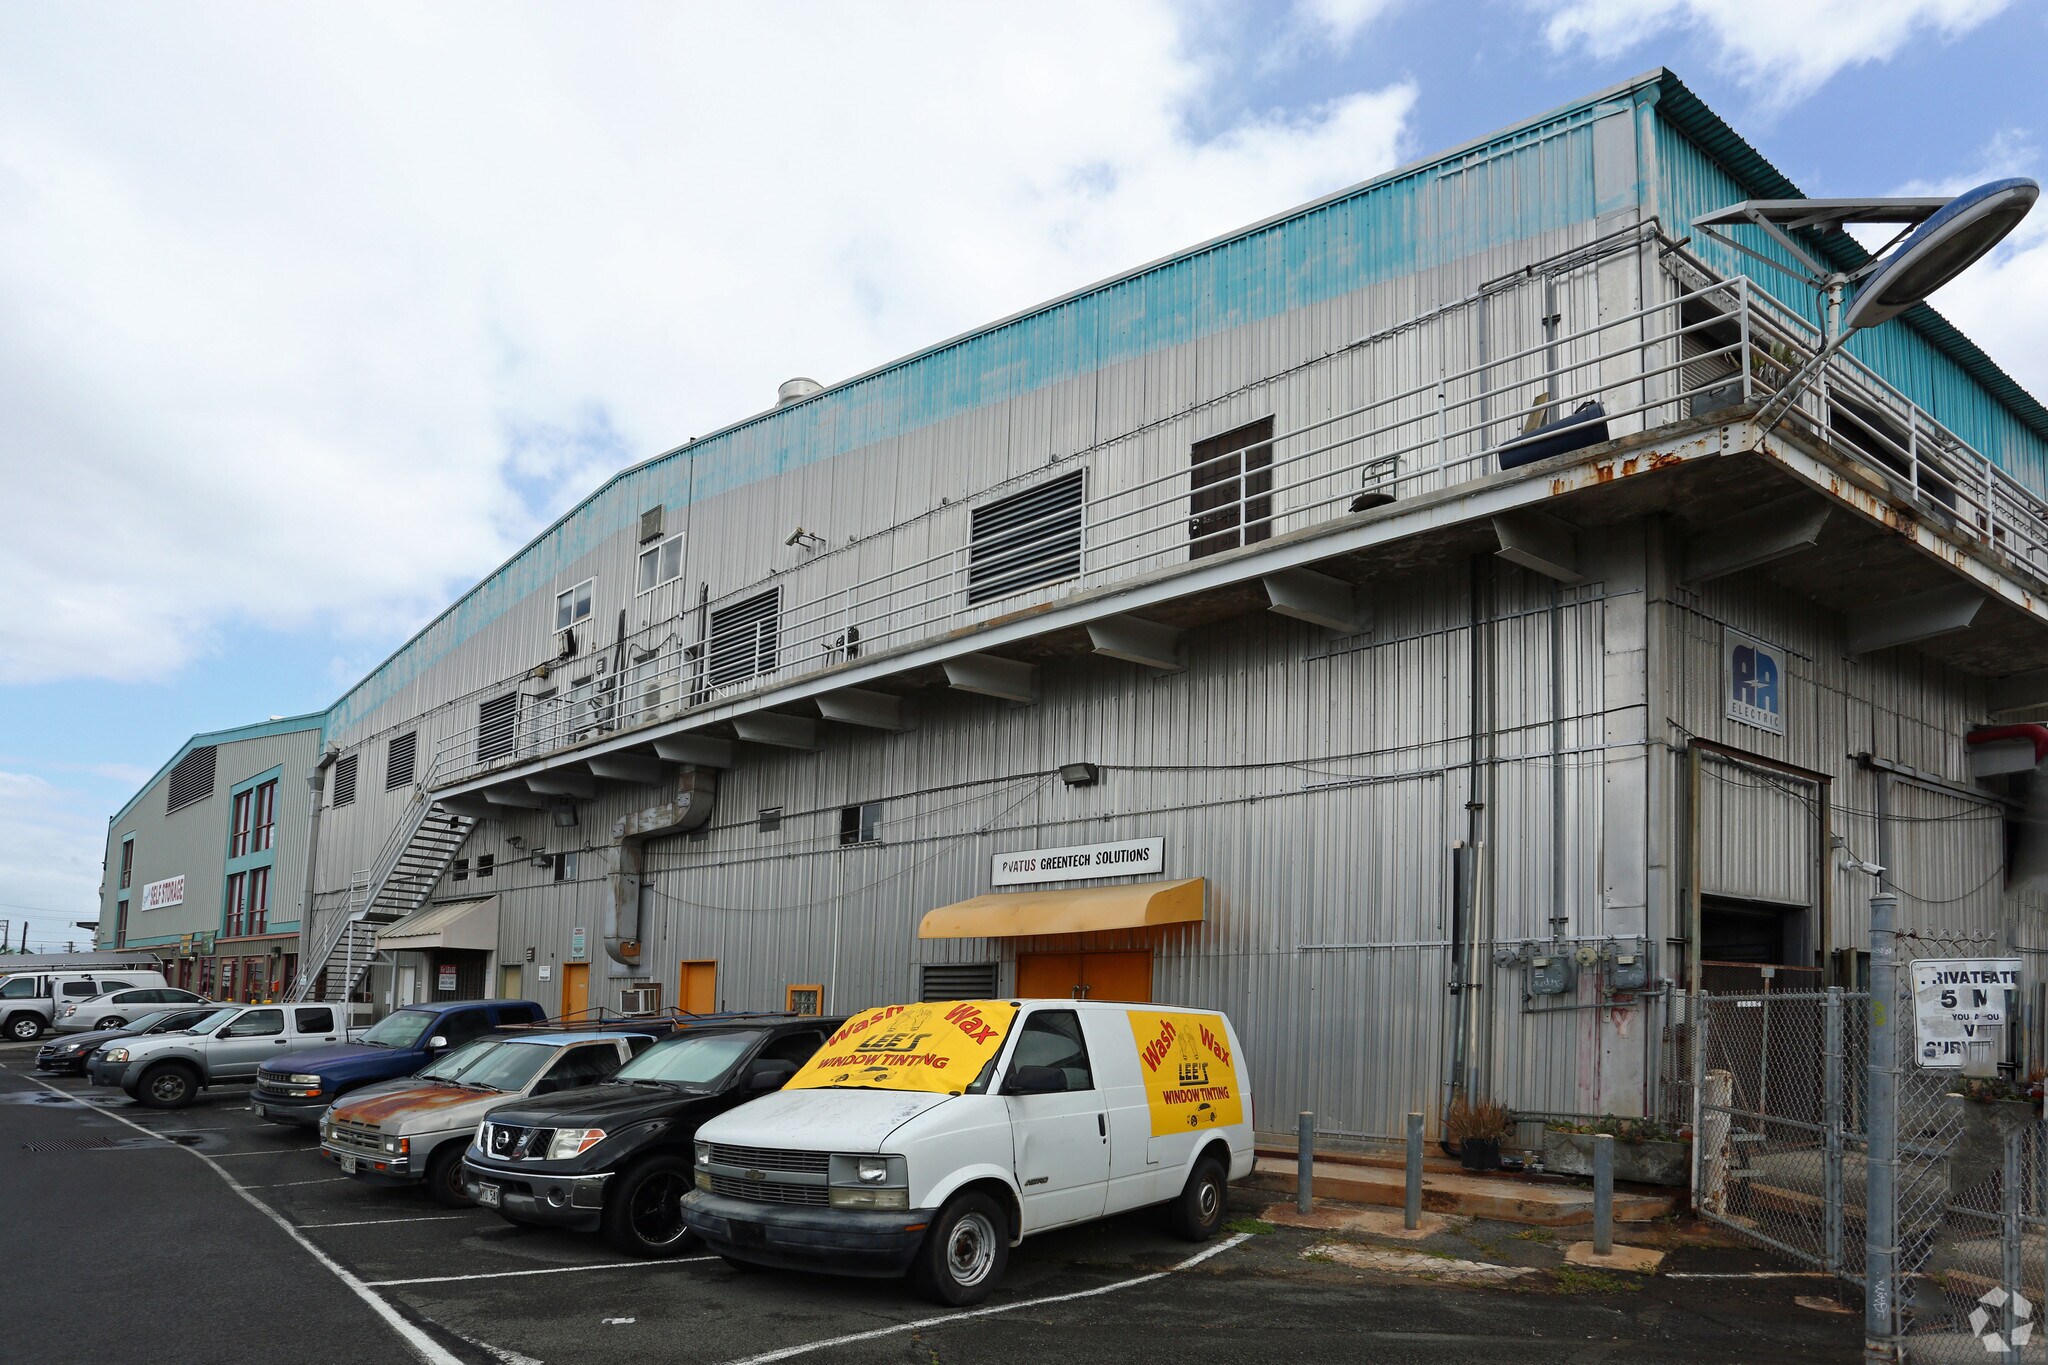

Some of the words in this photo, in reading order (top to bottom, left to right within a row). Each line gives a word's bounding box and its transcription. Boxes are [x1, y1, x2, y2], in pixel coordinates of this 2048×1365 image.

[1732, 703, 1779, 727] ELECTRIC
[1040, 854, 1090, 870] GREENTECH
[1095, 847, 1150, 865] SOLUTIONS
[150, 884, 161, 906] SELF
[161, 878, 184, 904] STORAGE
[1940, 989, 1957, 1008] 5
[828, 1006, 904, 1047] Wash
[944, 1003, 999, 1045] Wax
[1952, 1013, 1969, 1021] YOU
[854, 1032, 933, 1052] LEE'S
[1142, 1019, 1176, 1073] Wash
[1199, 1023, 1230, 1068] Wax
[817, 1053, 883, 1070] WINDOW
[1178, 1062, 1209, 1087] LEE'S
[1162, 1088, 1200, 1105] WINDOW
[1199, 1086, 1230, 1103] TINTING
